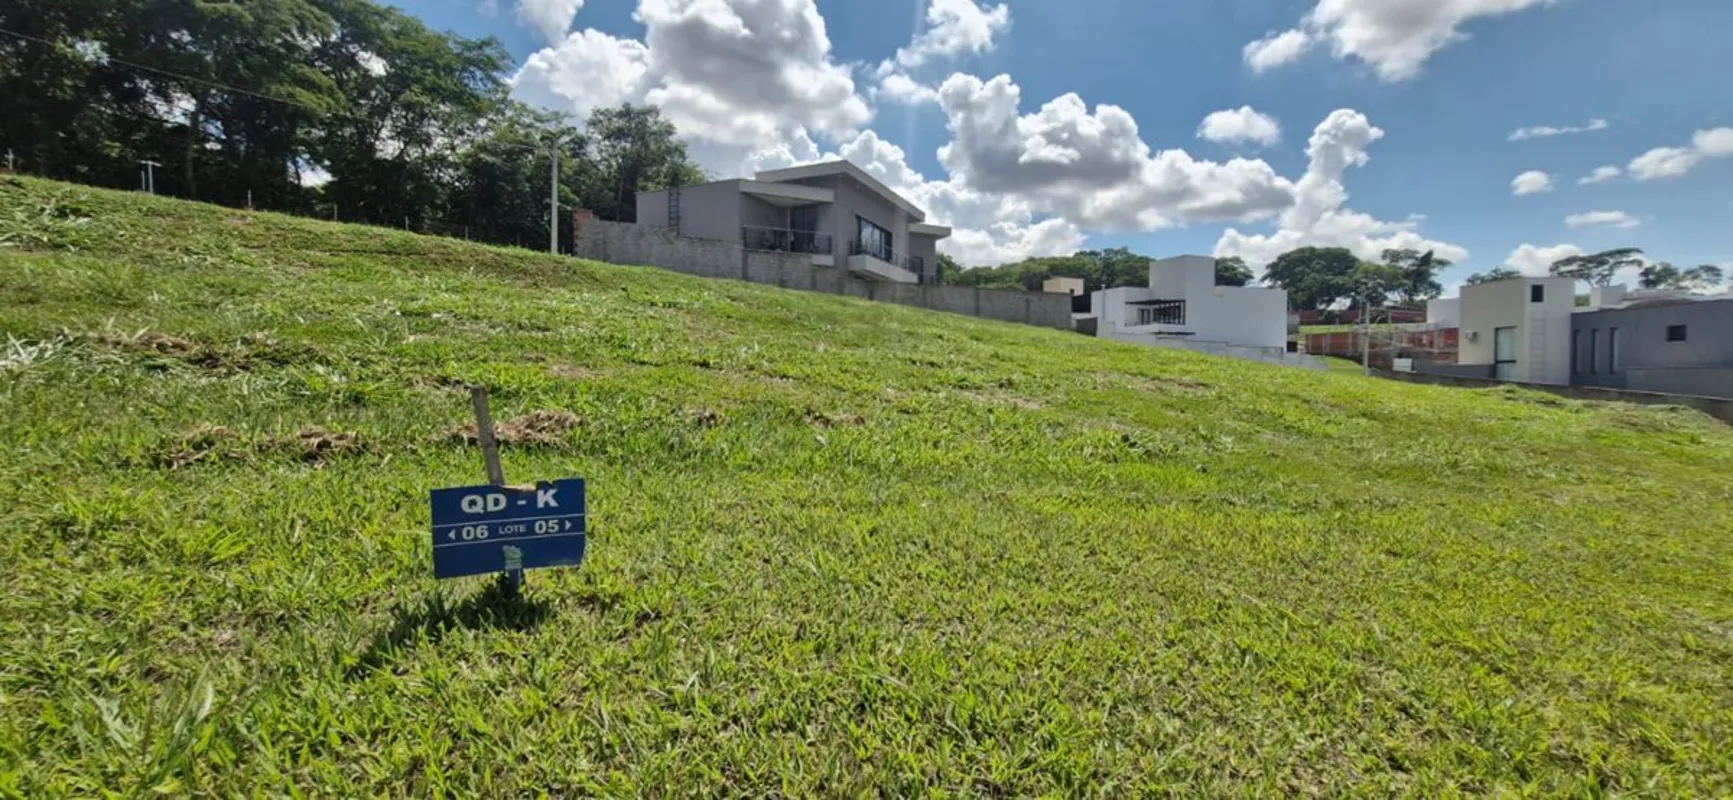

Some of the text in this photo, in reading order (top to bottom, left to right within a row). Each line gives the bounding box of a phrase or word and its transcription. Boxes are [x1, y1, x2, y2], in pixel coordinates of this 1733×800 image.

[461, 493, 507, 514] QD
[537, 489, 559, 508] K
[461, 519, 560, 540] 06 LOTE 05
